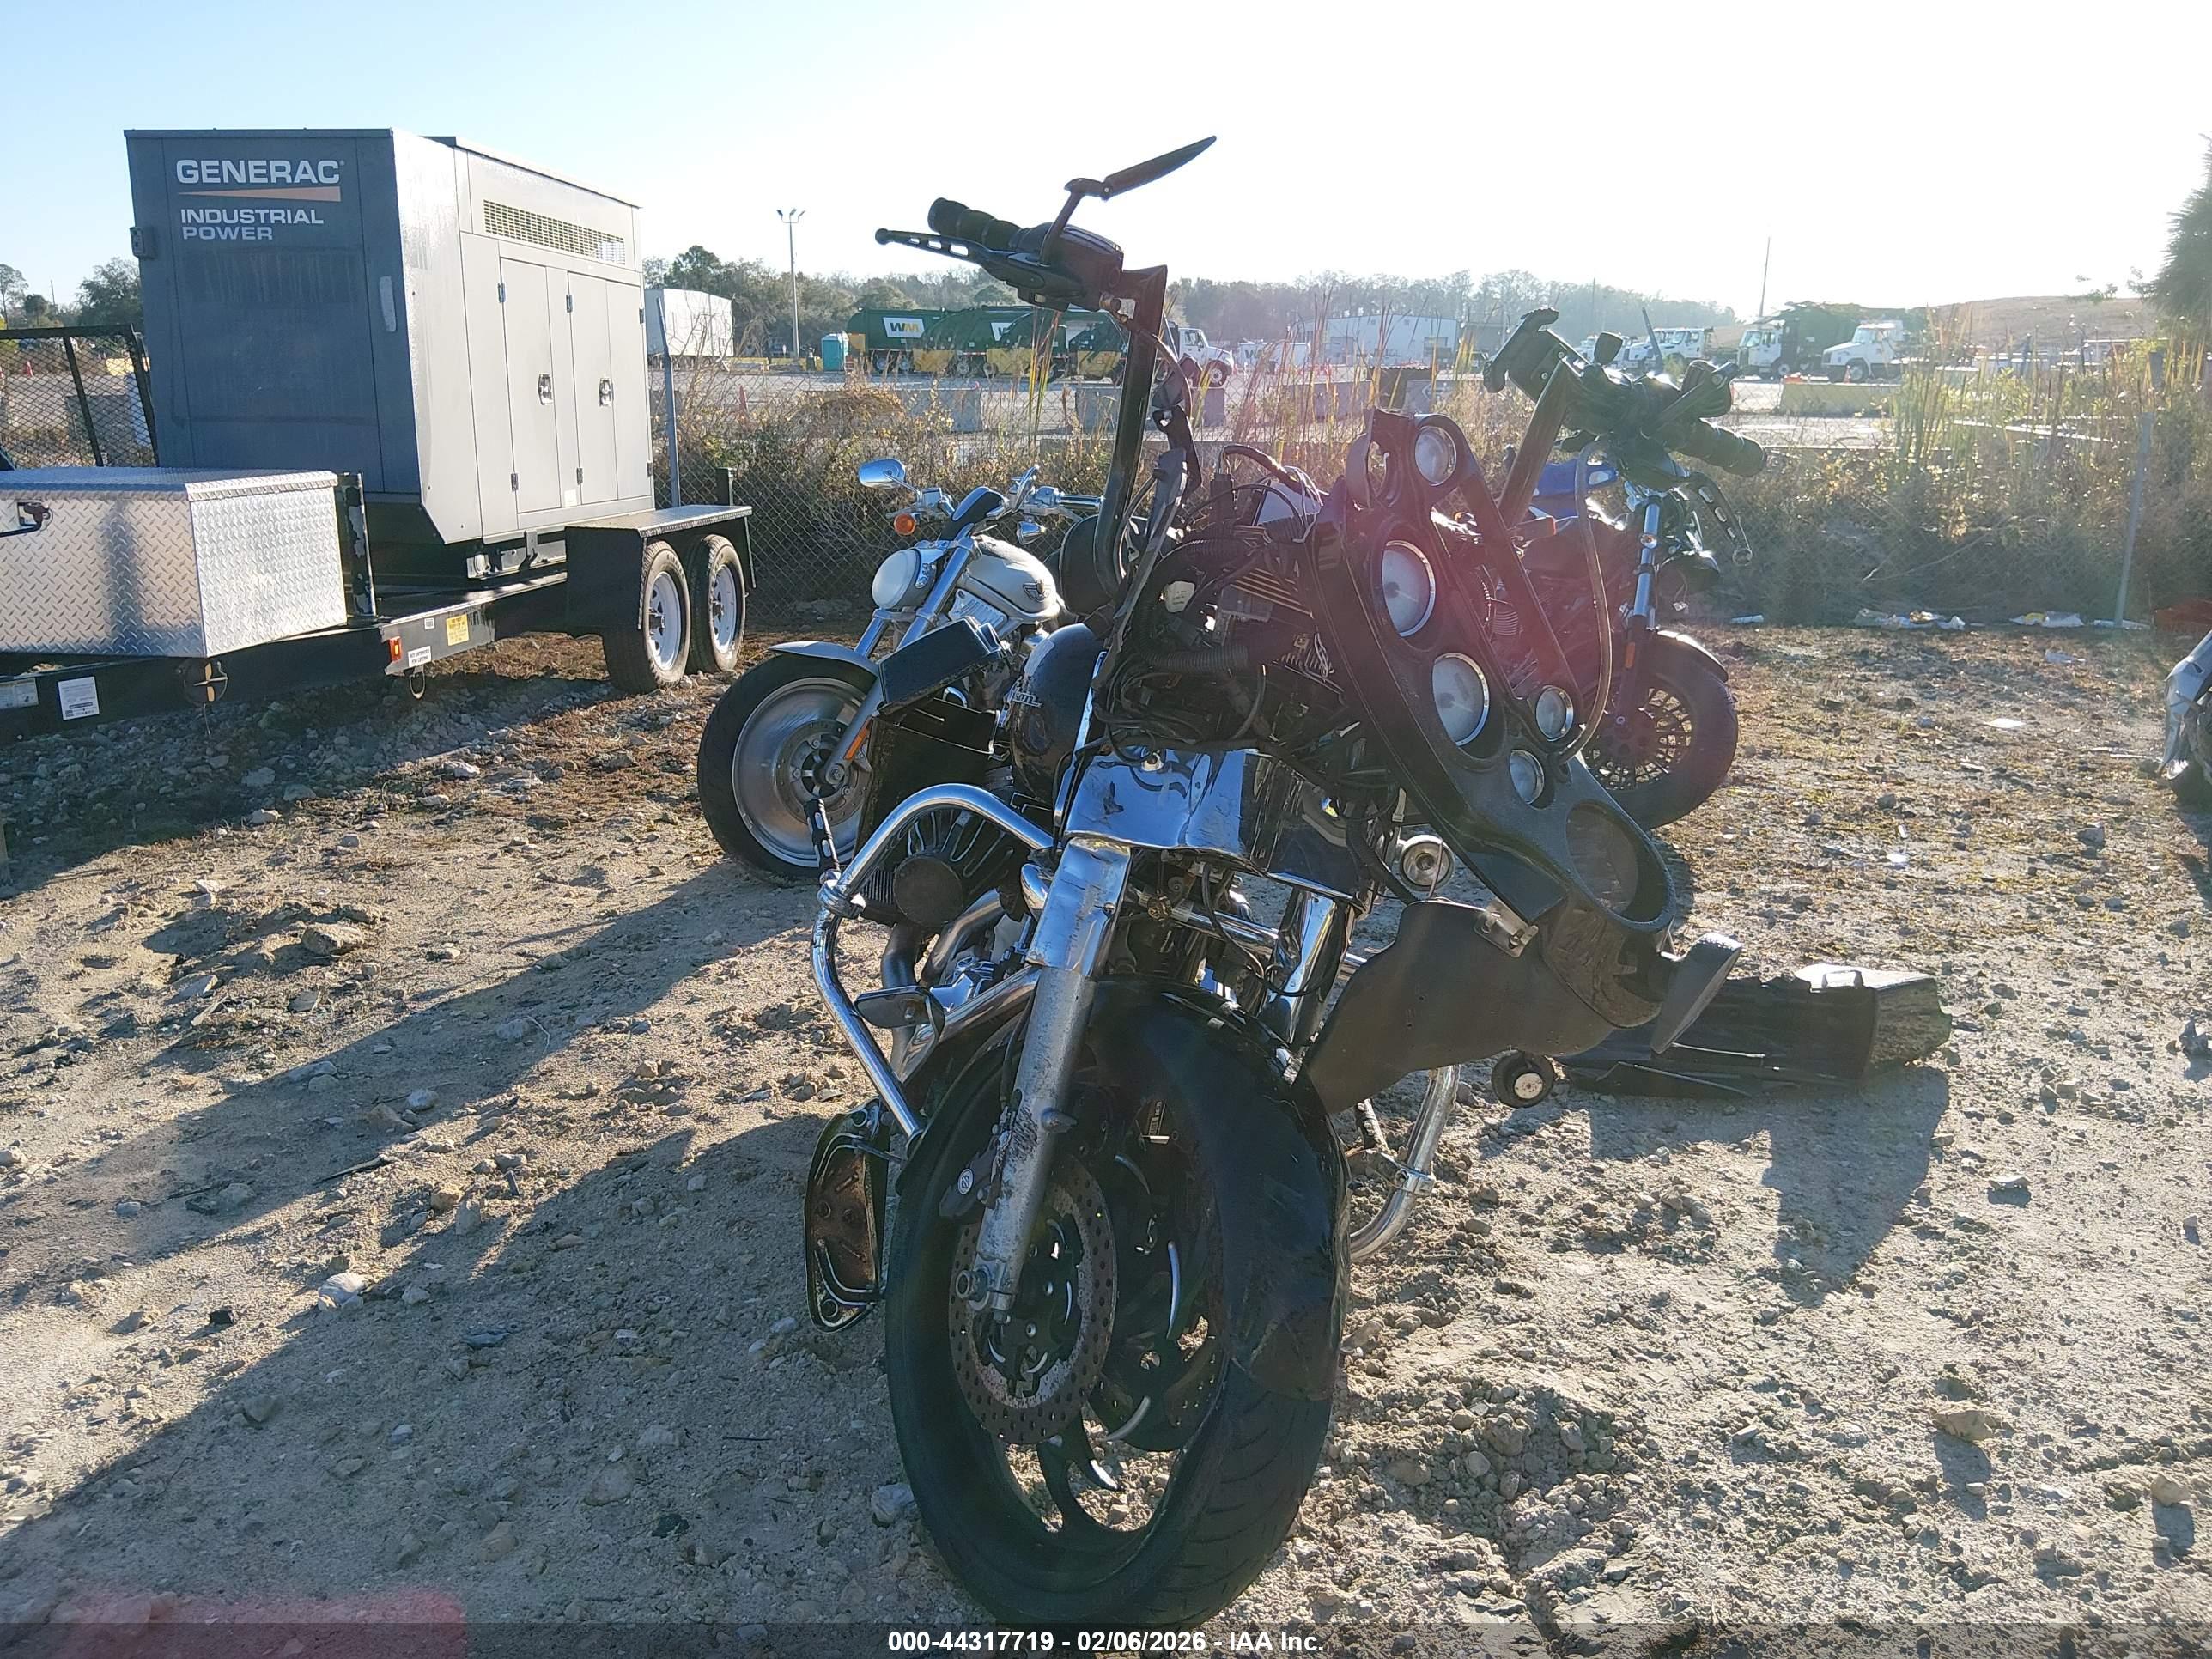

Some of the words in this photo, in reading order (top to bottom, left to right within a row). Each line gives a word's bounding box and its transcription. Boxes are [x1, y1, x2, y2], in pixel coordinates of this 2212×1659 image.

[176, 159, 341, 184] GENERAC
[180, 209, 324, 224] INDUSTRIAL
[182, 226, 273, 240] POWER
[890, 322, 919, 332] WM
